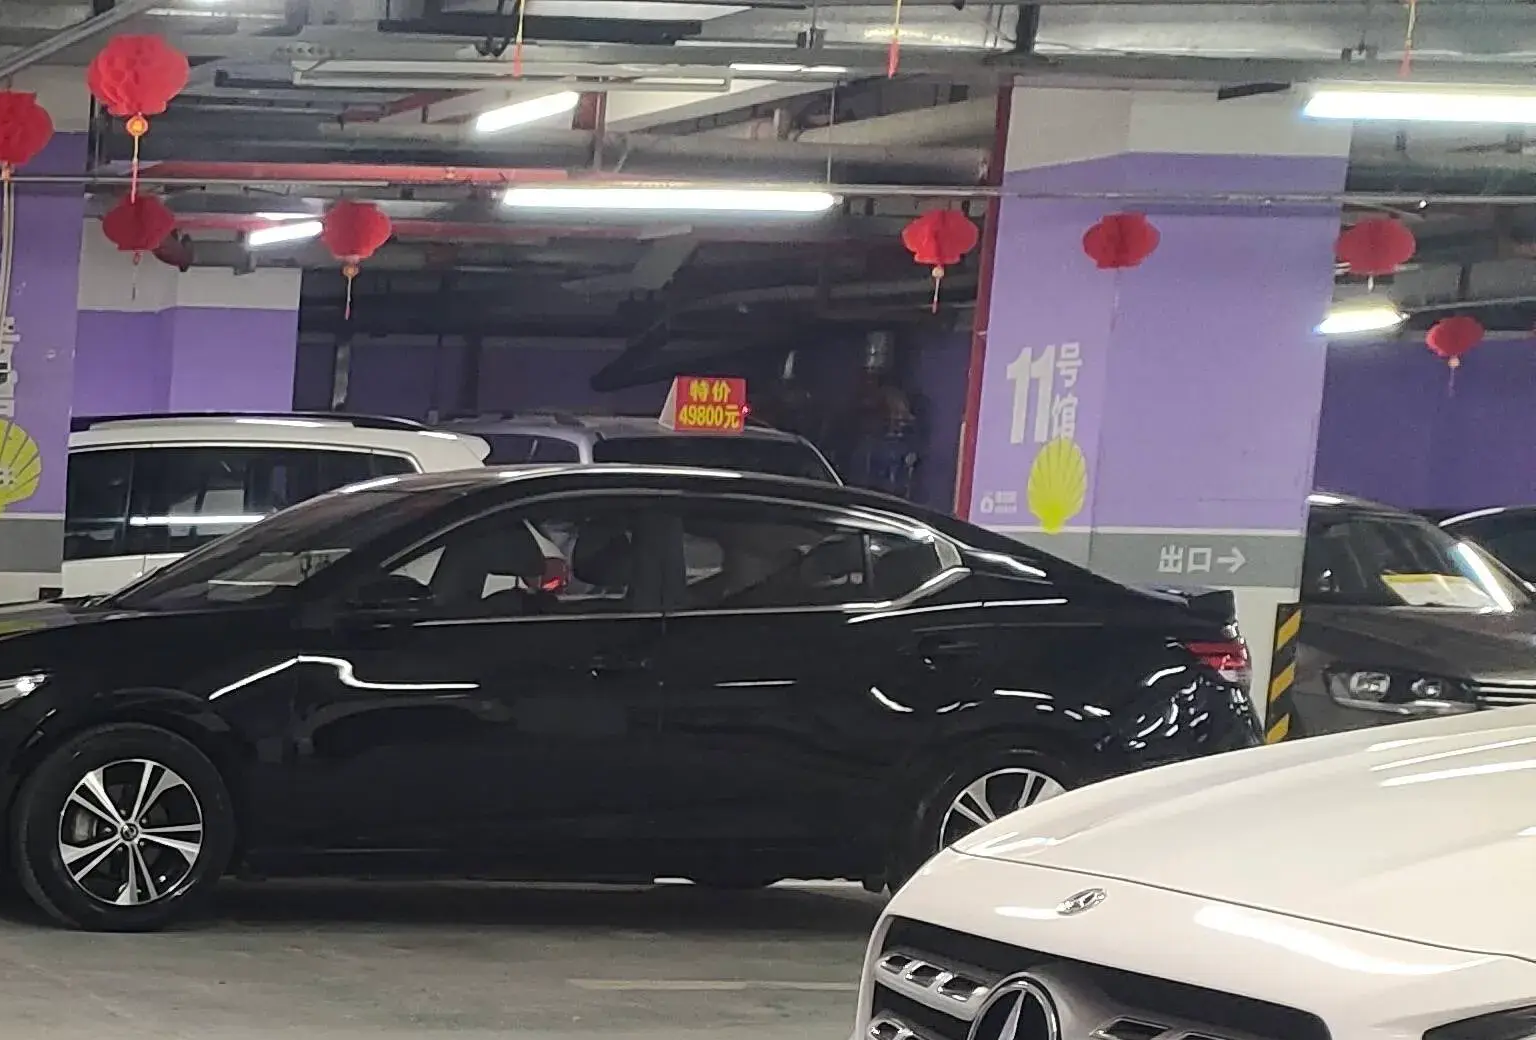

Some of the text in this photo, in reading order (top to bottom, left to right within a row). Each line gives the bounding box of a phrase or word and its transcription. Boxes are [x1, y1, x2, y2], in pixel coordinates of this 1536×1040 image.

[689, 379, 731, 402] 特价
[1006, 344, 1056, 444] 11
[678, 403, 740, 429] 49800元
[1156, 543, 1213, 574] 出口
